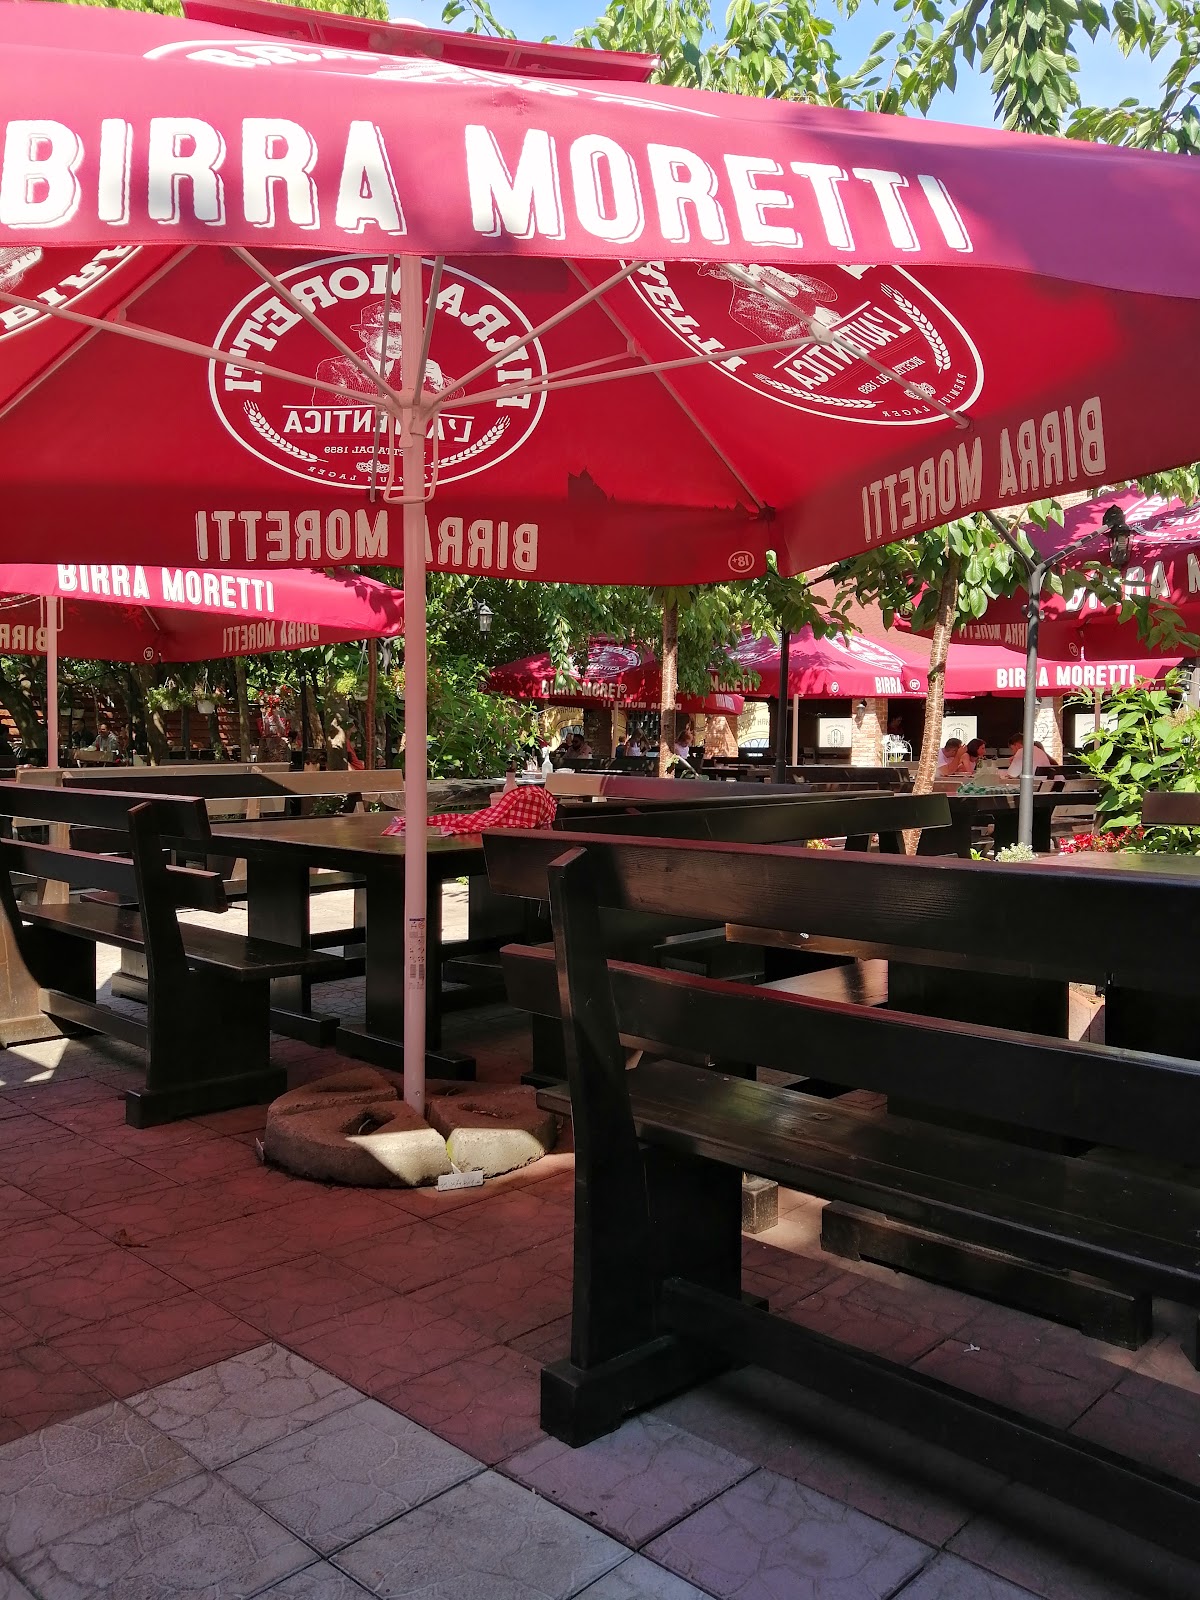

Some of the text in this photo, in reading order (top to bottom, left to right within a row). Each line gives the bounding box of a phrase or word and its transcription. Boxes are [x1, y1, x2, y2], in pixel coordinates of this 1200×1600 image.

[0, 117, 973, 254] BIRRA MORETTI
[57, 564, 274, 612] BIRRA MORETTI
[874, 676, 905, 694] BIRRA
[997, 664, 1137, 689] BIRA MORETTI
